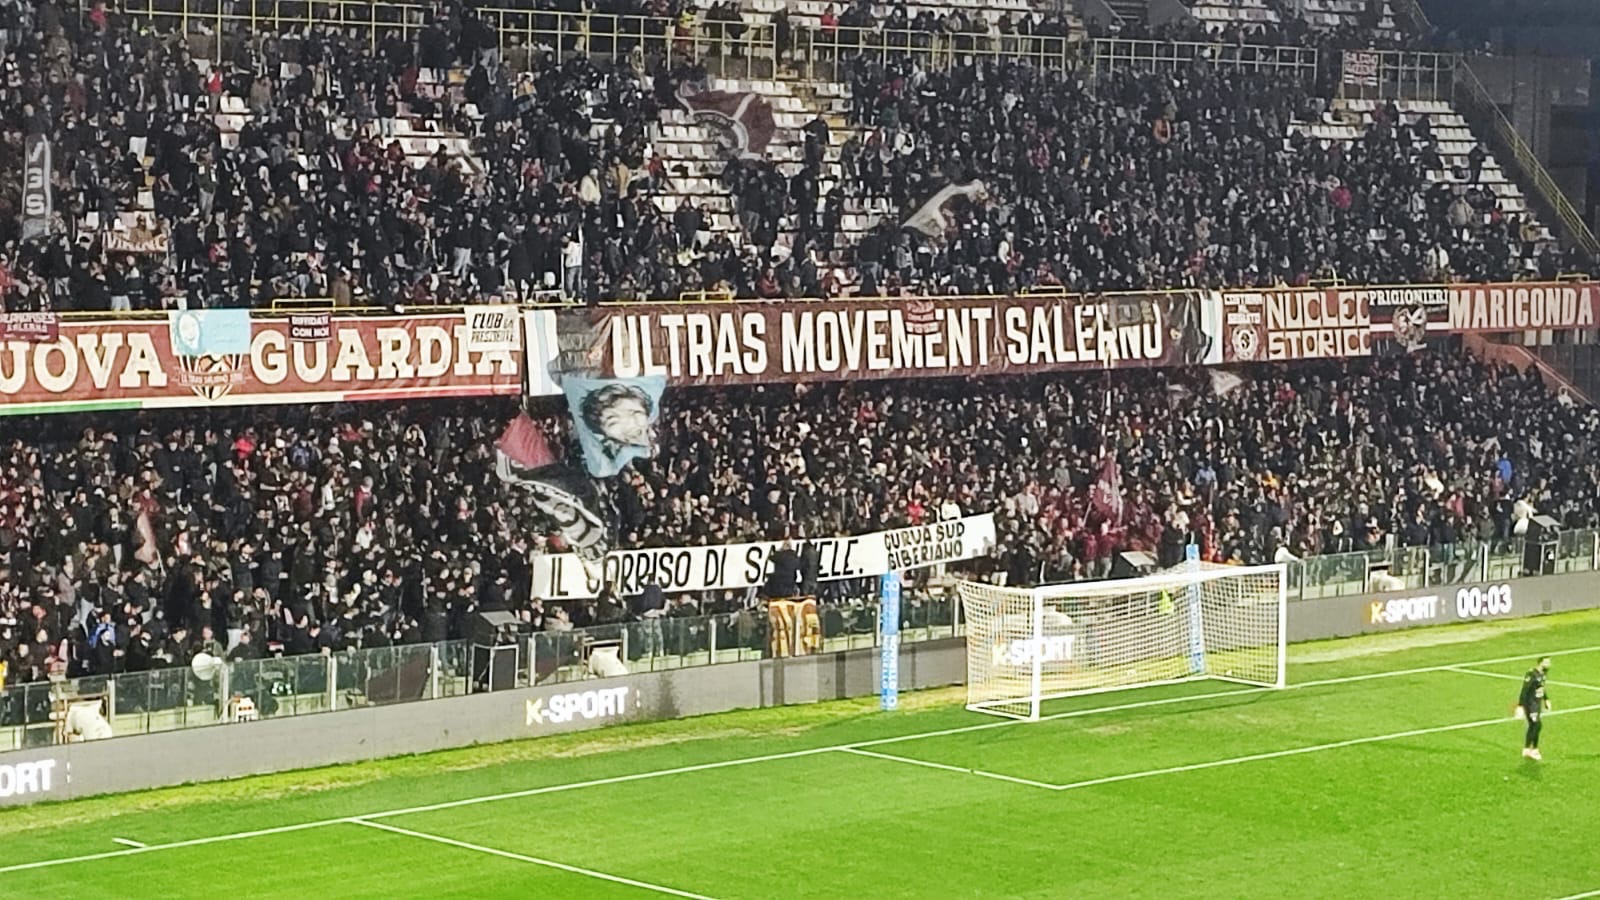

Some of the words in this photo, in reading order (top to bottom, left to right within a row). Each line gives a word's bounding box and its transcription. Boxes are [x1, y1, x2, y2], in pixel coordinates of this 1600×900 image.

[1368, 289, 1448, 305] PRIGIONIERI
[1450, 287, 1593, 329] MARICONDA
[472, 313, 503, 329] CLUB
[612, 311, 767, 378] ULTRAS
[781, 307, 992, 372] MOVEMENT
[884, 527, 932, 551] CURVA
[936, 522, 965, 541] SUD
[550, 557, 569, 597] IL
[704, 548, 727, 586] DI
[1370, 595, 1438, 624] K-SPORT
[1456, 584, 1512, 618] 00:03
[526, 686, 628, 726] K-SPORT
[0, 759, 56, 797] ORT
